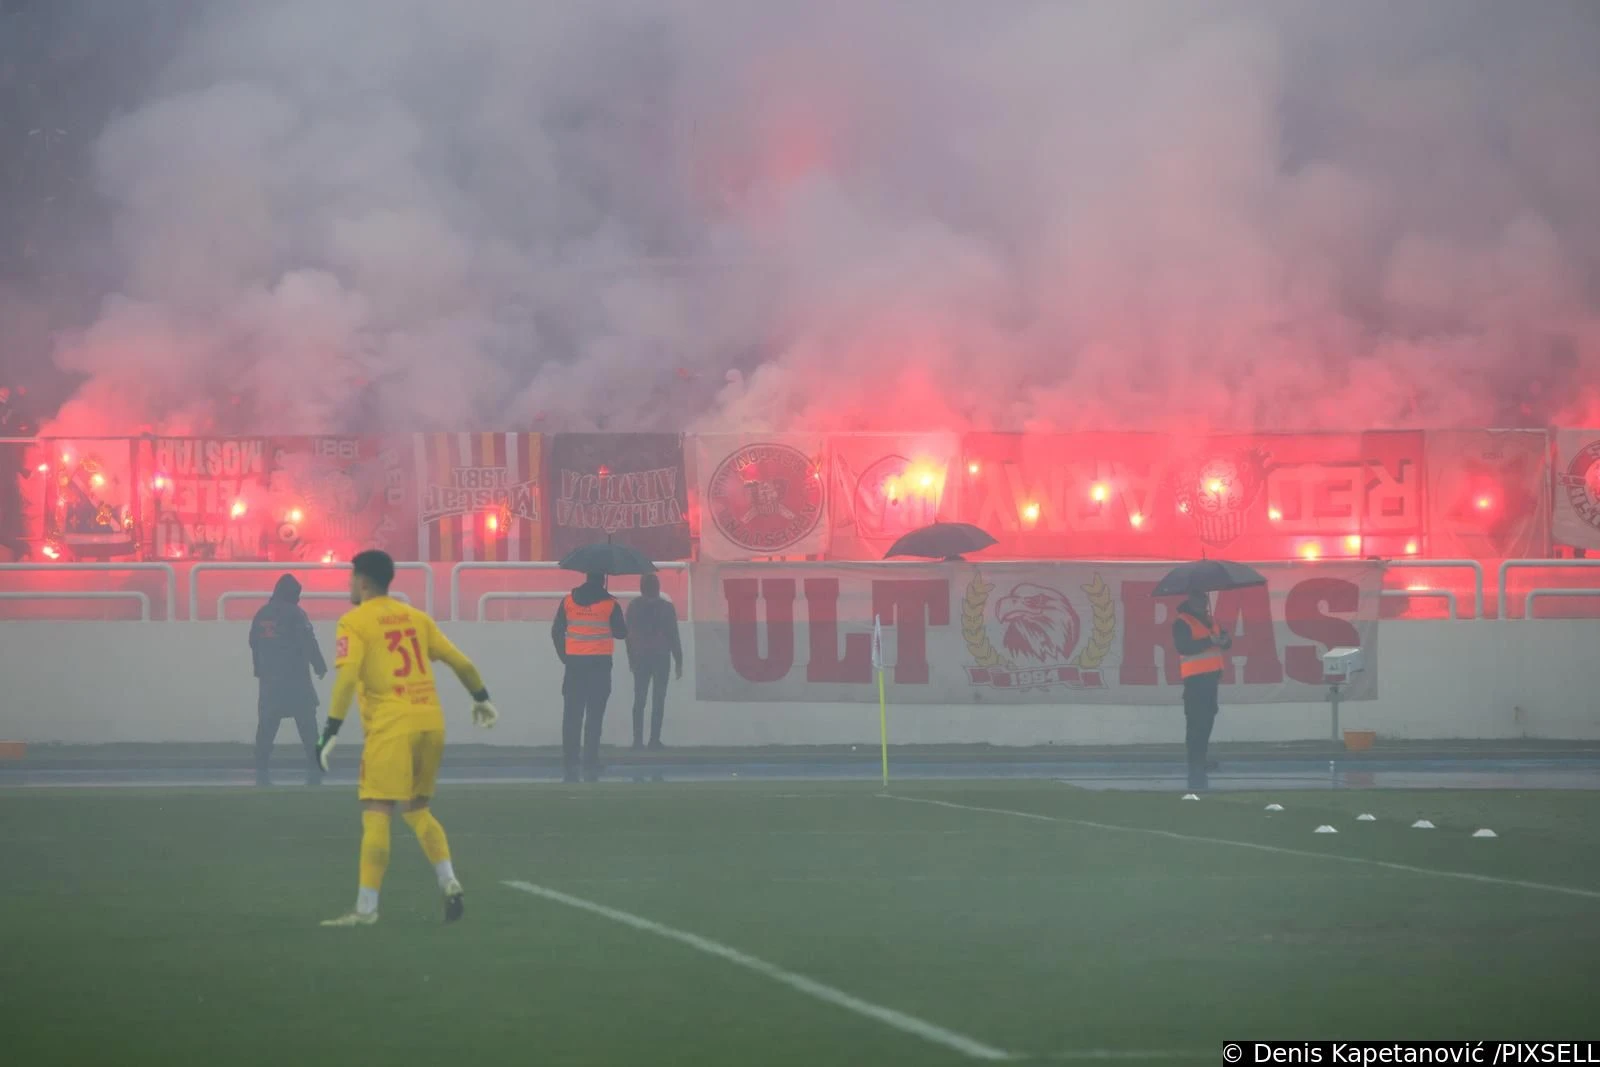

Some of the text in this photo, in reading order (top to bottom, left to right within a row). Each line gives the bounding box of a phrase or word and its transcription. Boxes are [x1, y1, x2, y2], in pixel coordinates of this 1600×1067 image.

[156, 440, 263, 477] MOSTAR
[423, 482, 540, 524] Mostar
[560, 467, 678, 503] ARMIJA
[978, 460, 1418, 535] RED ARMY
[384, 628, 426, 678] 31
